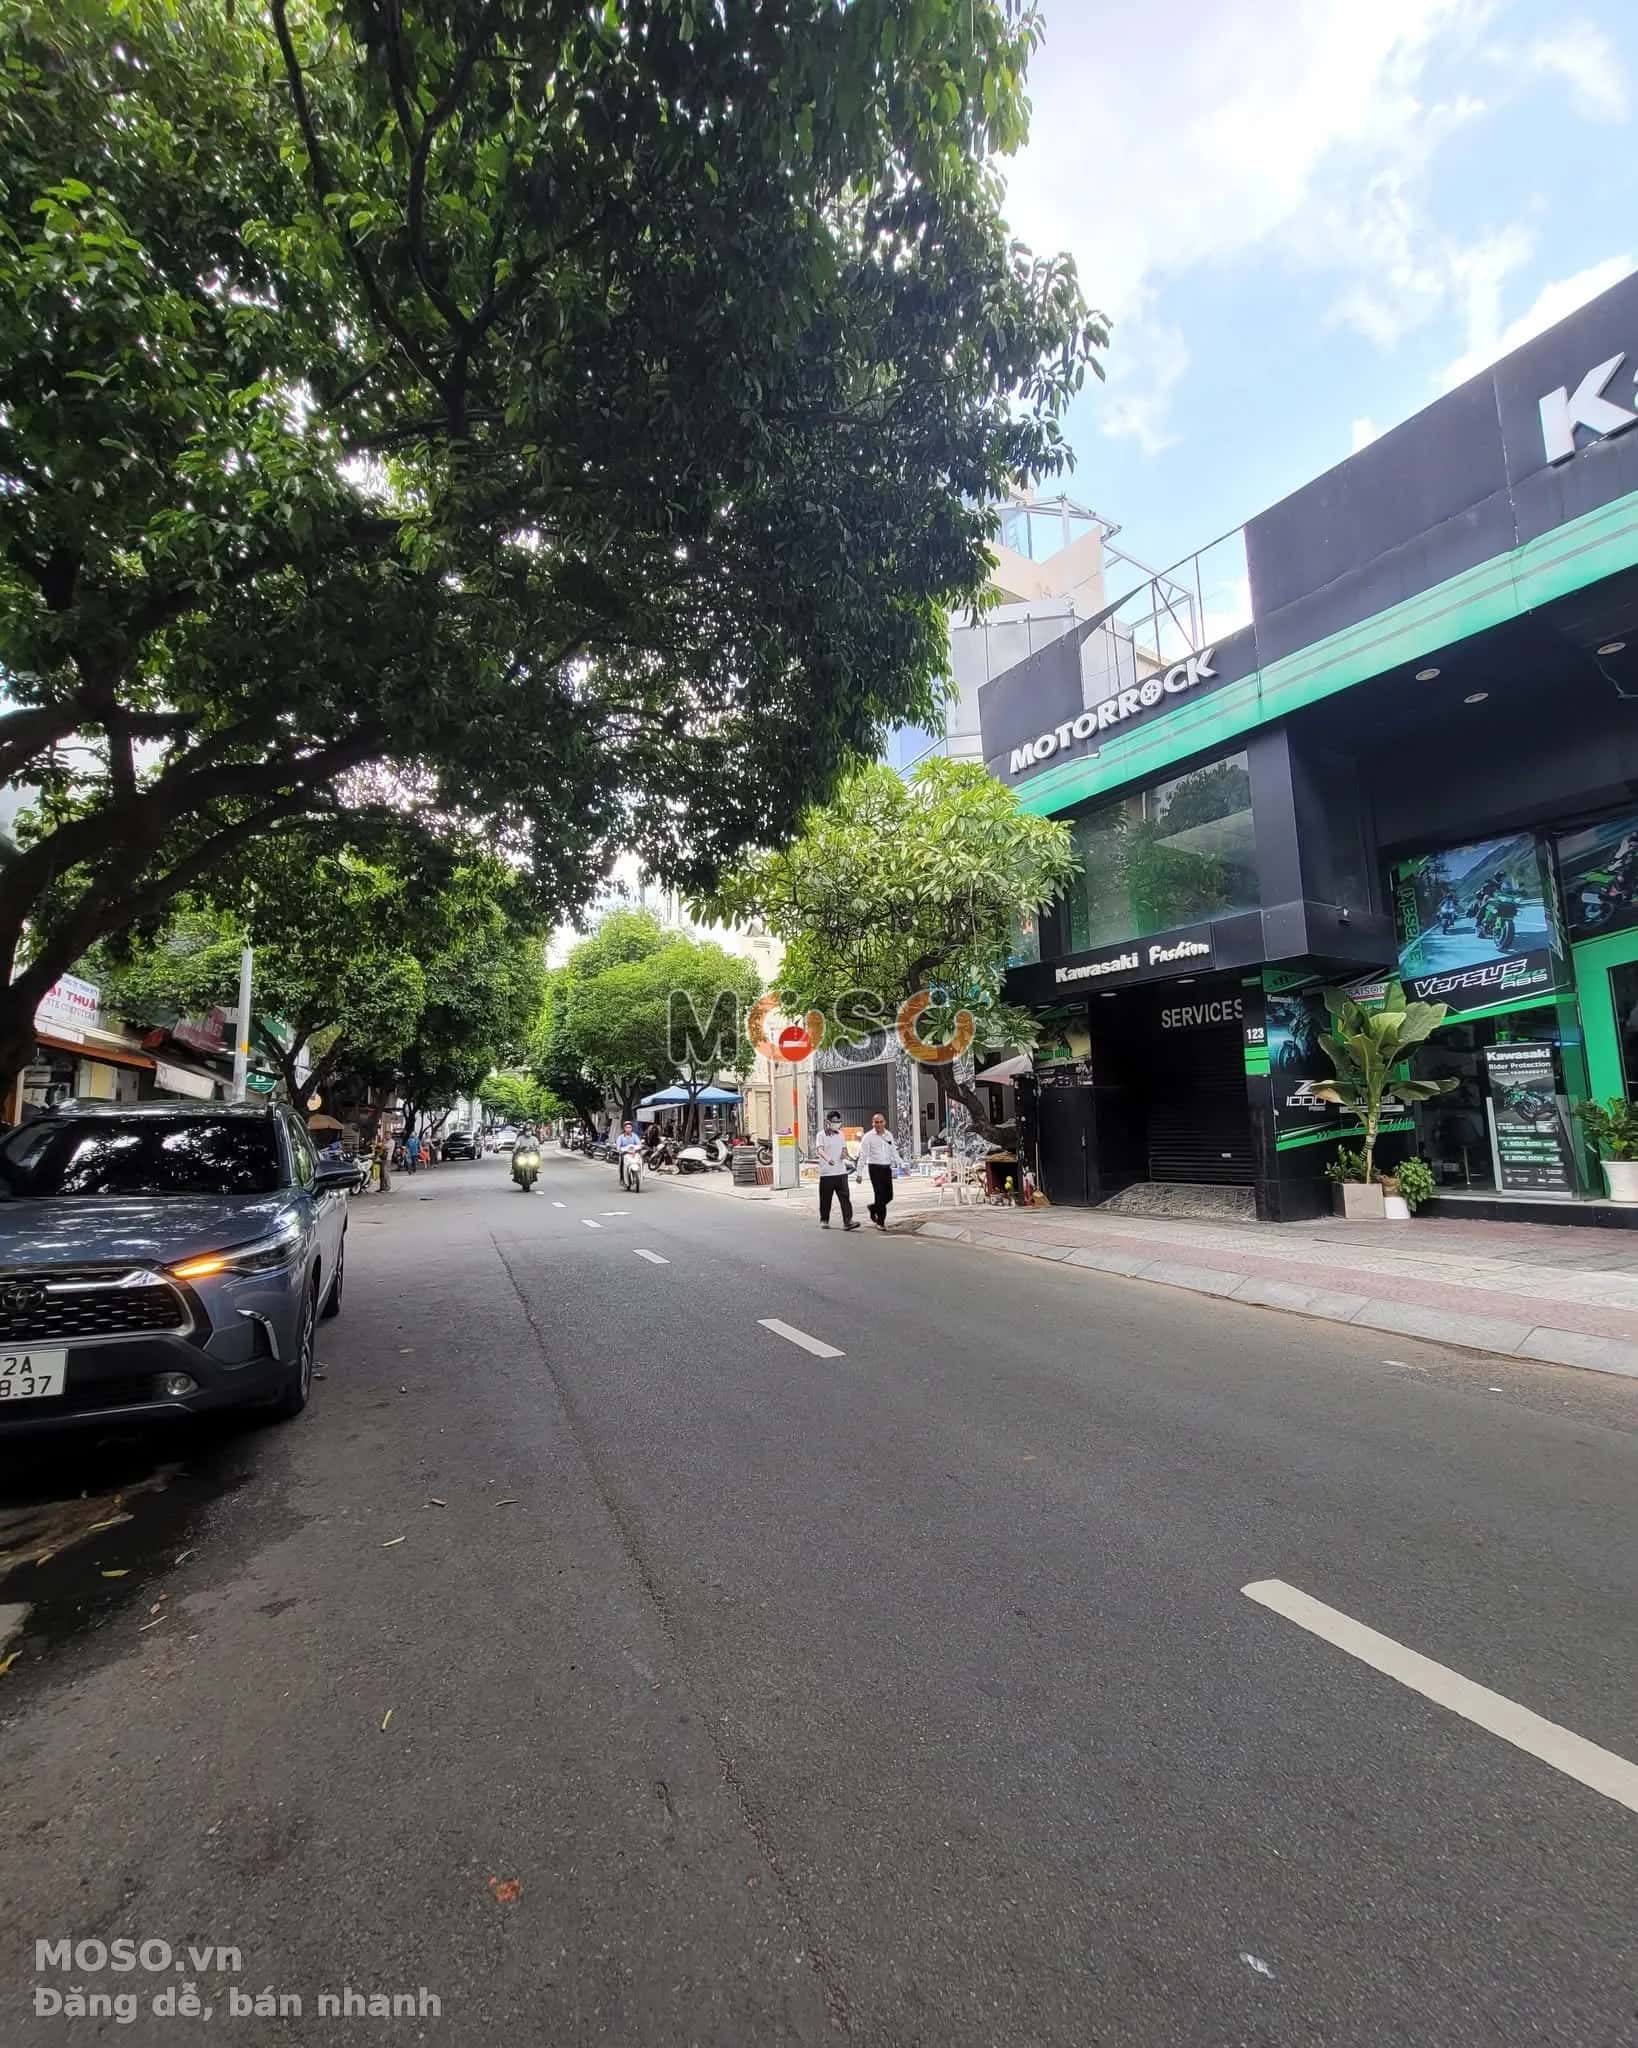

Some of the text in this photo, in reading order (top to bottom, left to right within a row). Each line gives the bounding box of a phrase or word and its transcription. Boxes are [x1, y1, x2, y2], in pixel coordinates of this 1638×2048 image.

[1539, 351, 1638, 464] K
[1009, 648, 1218, 775] MOTORROCK
[1055, 942, 1210, 983] Kawasaki Fashion
[1161, 998, 1243, 1029] SERVICES
[1246, 1027, 1264, 1040] 123
[1486, 1048, 1551, 1061] Kawasaki
[3, 1356, 32, 1376] 2A
